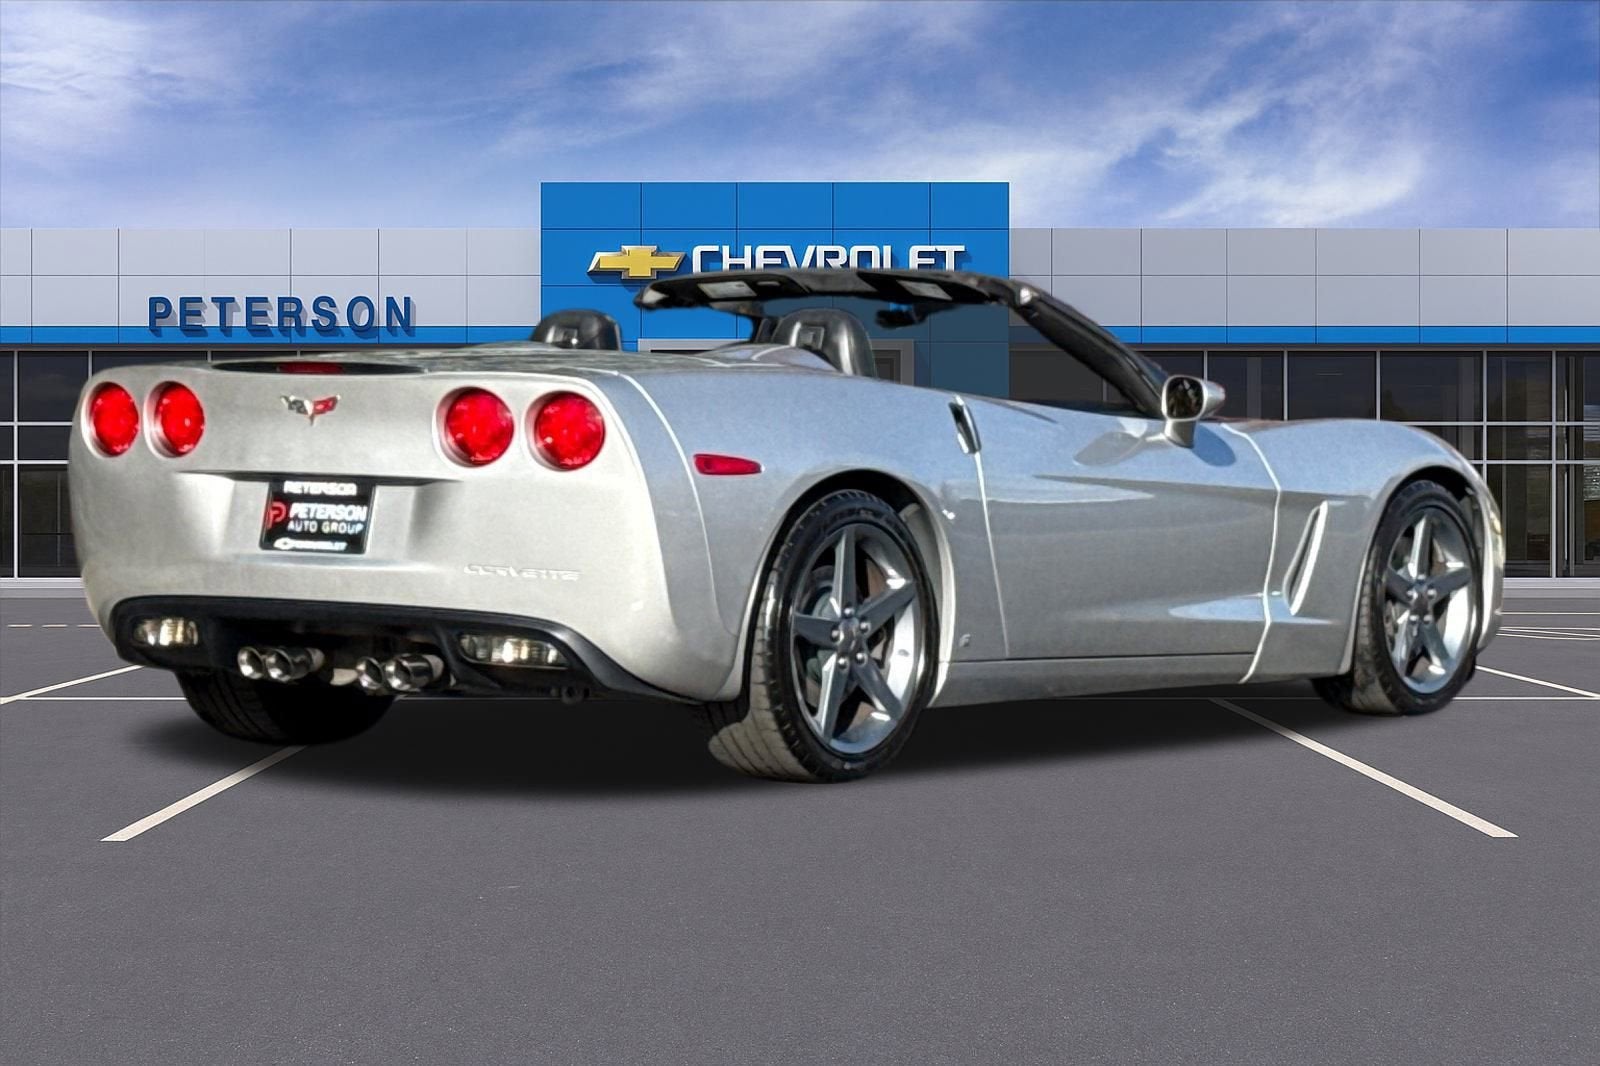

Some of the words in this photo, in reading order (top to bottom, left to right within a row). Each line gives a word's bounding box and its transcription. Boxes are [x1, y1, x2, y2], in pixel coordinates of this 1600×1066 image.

[148, 296, 411, 332] PETERSON
[289, 502, 368, 521] PETERSON
[287, 520, 318, 533] AUTO
[321, 521, 364, 535] GROUP
